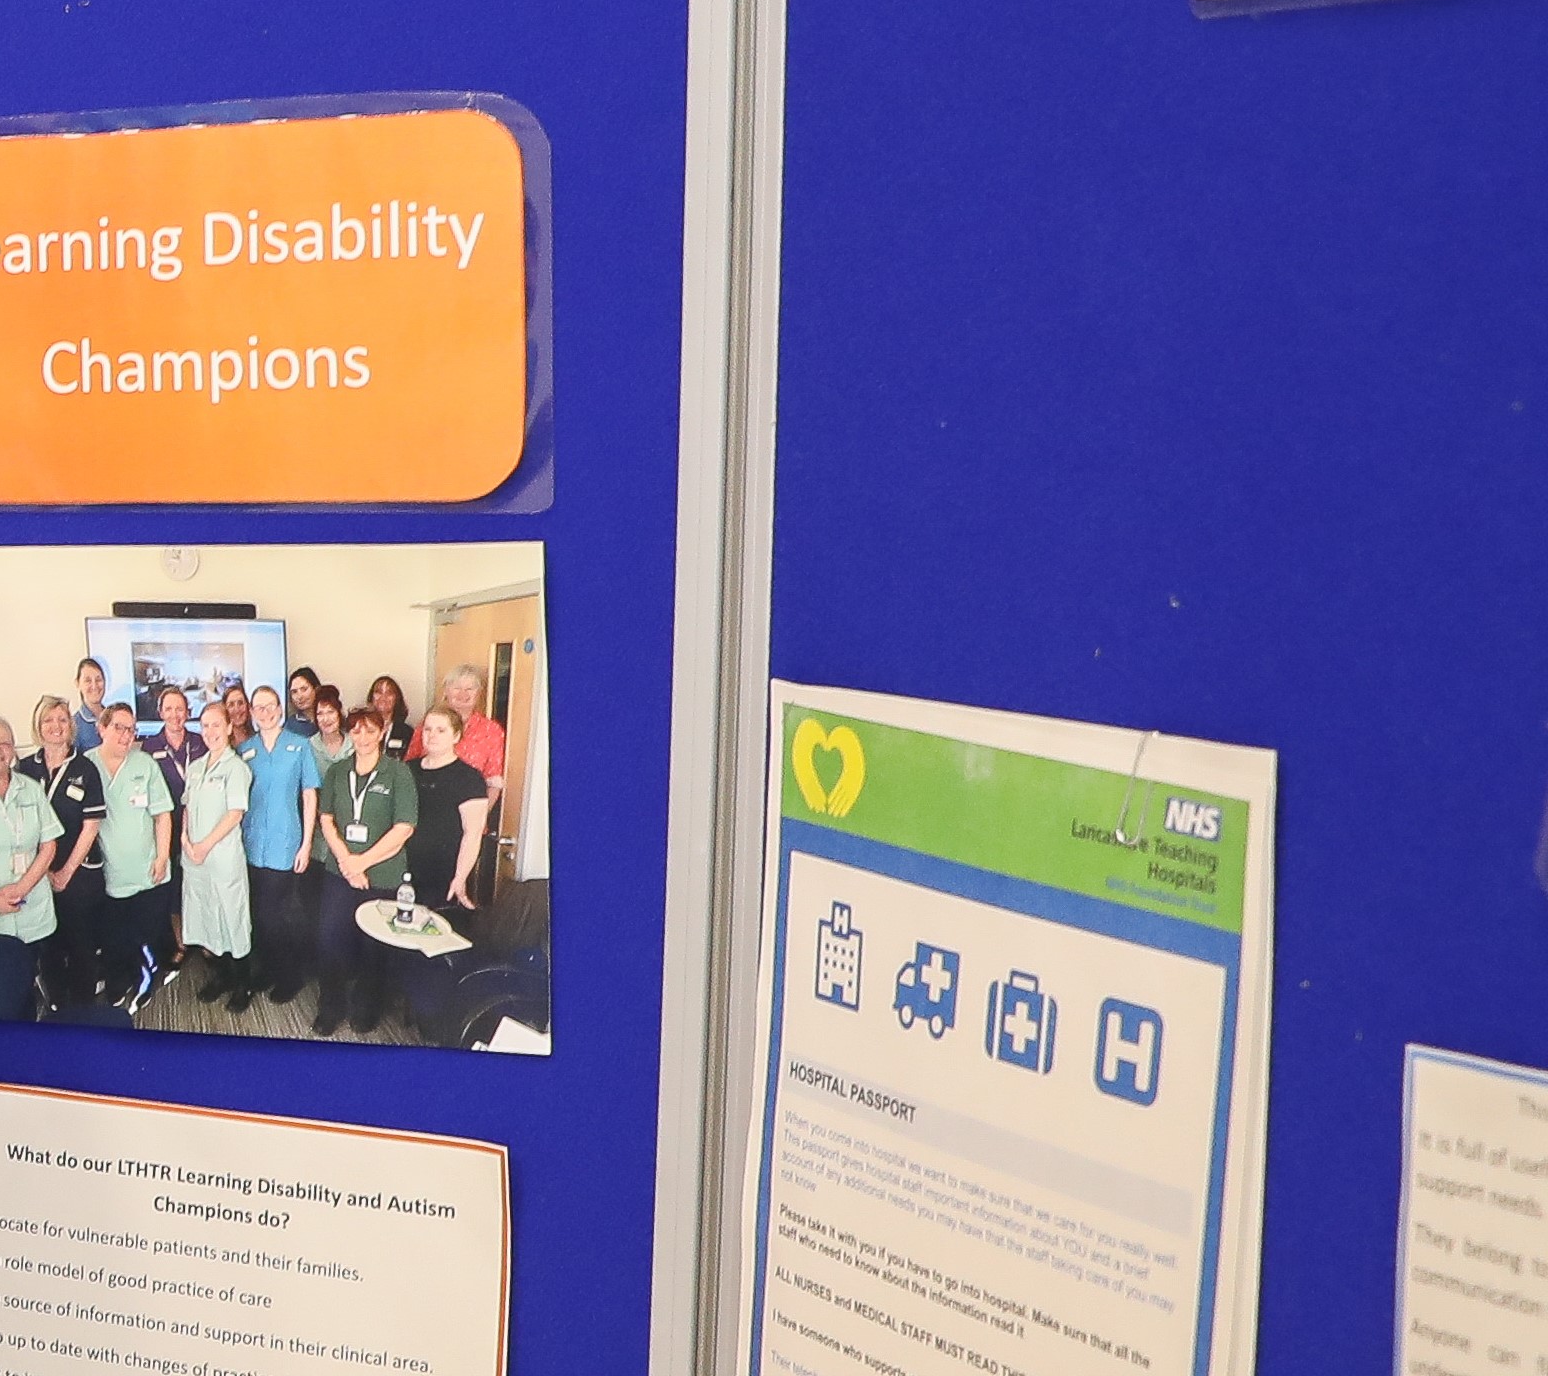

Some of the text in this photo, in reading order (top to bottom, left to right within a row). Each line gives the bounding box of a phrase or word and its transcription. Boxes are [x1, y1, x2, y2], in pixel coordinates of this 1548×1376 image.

[203, 198, 485, 269] Disability
[42, 335, 371, 404] Champions
[1165, 798, 1220, 839] NHS
[1147, 862, 1216, 894] Hospitals
[1155, 836, 1219, 873] Teaching
[789, 1060, 917, 1124] HOSPITAL PASSPORT
[6, 1143, 456, 1219] What do our LTHTR Learning Disability and Autism
[153, 1195, 290, 1230] Champions do?
[4, 1254, 34, 1273] role
[37, 1261, 85, 1281] model
[88, 1266, 105, 1284] of
[107, 1273, 148, 1290] good
[151, 1279, 215, 1300] practice
[218, 1286, 236, 1303] of
[239, 1292, 272, 1309] care
[42, 1219, 65, 1239] for
[67, 1226, 149, 1251] vulnerable
[153, 1239, 217, 1261] patients
[221, 1248, 251, 1265] and
[254, 1251, 293, 1271] their
[296, 1256, 364, 1282] families.
[774, 1264, 792, 1285] ALL
[793, 1272, 833, 1303] NURSES
[833, 1294, 853, 1312] and
[853, 1299, 899, 1334] MEDICAL
[899, 1320, 933, 1347] STAFF
[934, 1335, 966, 1361] MUST
[966, 1350, 999, 1376] READ
